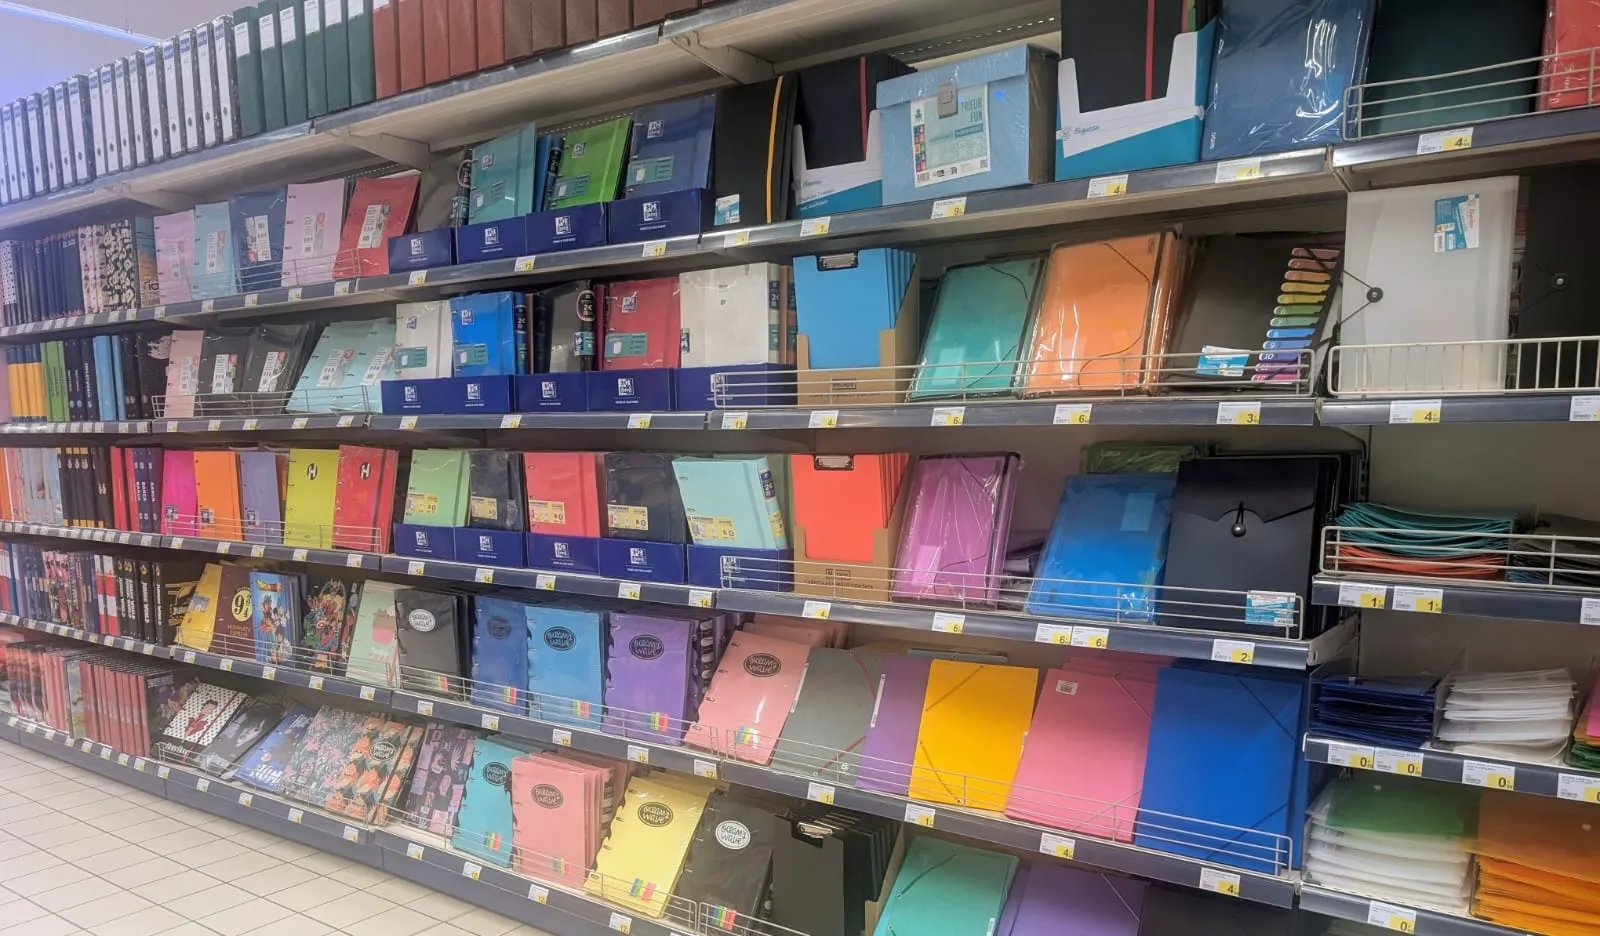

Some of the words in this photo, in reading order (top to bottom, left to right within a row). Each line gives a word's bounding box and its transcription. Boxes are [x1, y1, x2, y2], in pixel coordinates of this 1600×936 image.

[1454, 138, 1463, 148] 4
[1113, 184, 1121, 196] 4
[1263, 353, 1275, 361] 10
[952, 416, 960, 425] 6
[1078, 414, 1086, 424] 6
[1246, 412, 1254, 424] 3
[1424, 410, 1434, 422] 4
[1427, 600, 1434, 610] 1
[953, 624, 960, 633] 6
[1060, 635, 1068, 644] 6
[1096, 638, 1104, 648] 6
[1241, 653, 1249, 662] 2
[1360, 757, 1368, 767] 0
[1407, 763, 1415, 774] 0
[1498, 777, 1506, 788] 0
[1063, 849, 1070, 857] 4
[1228, 885, 1235, 894] 4
[1400, 921, 1409, 931] 0
